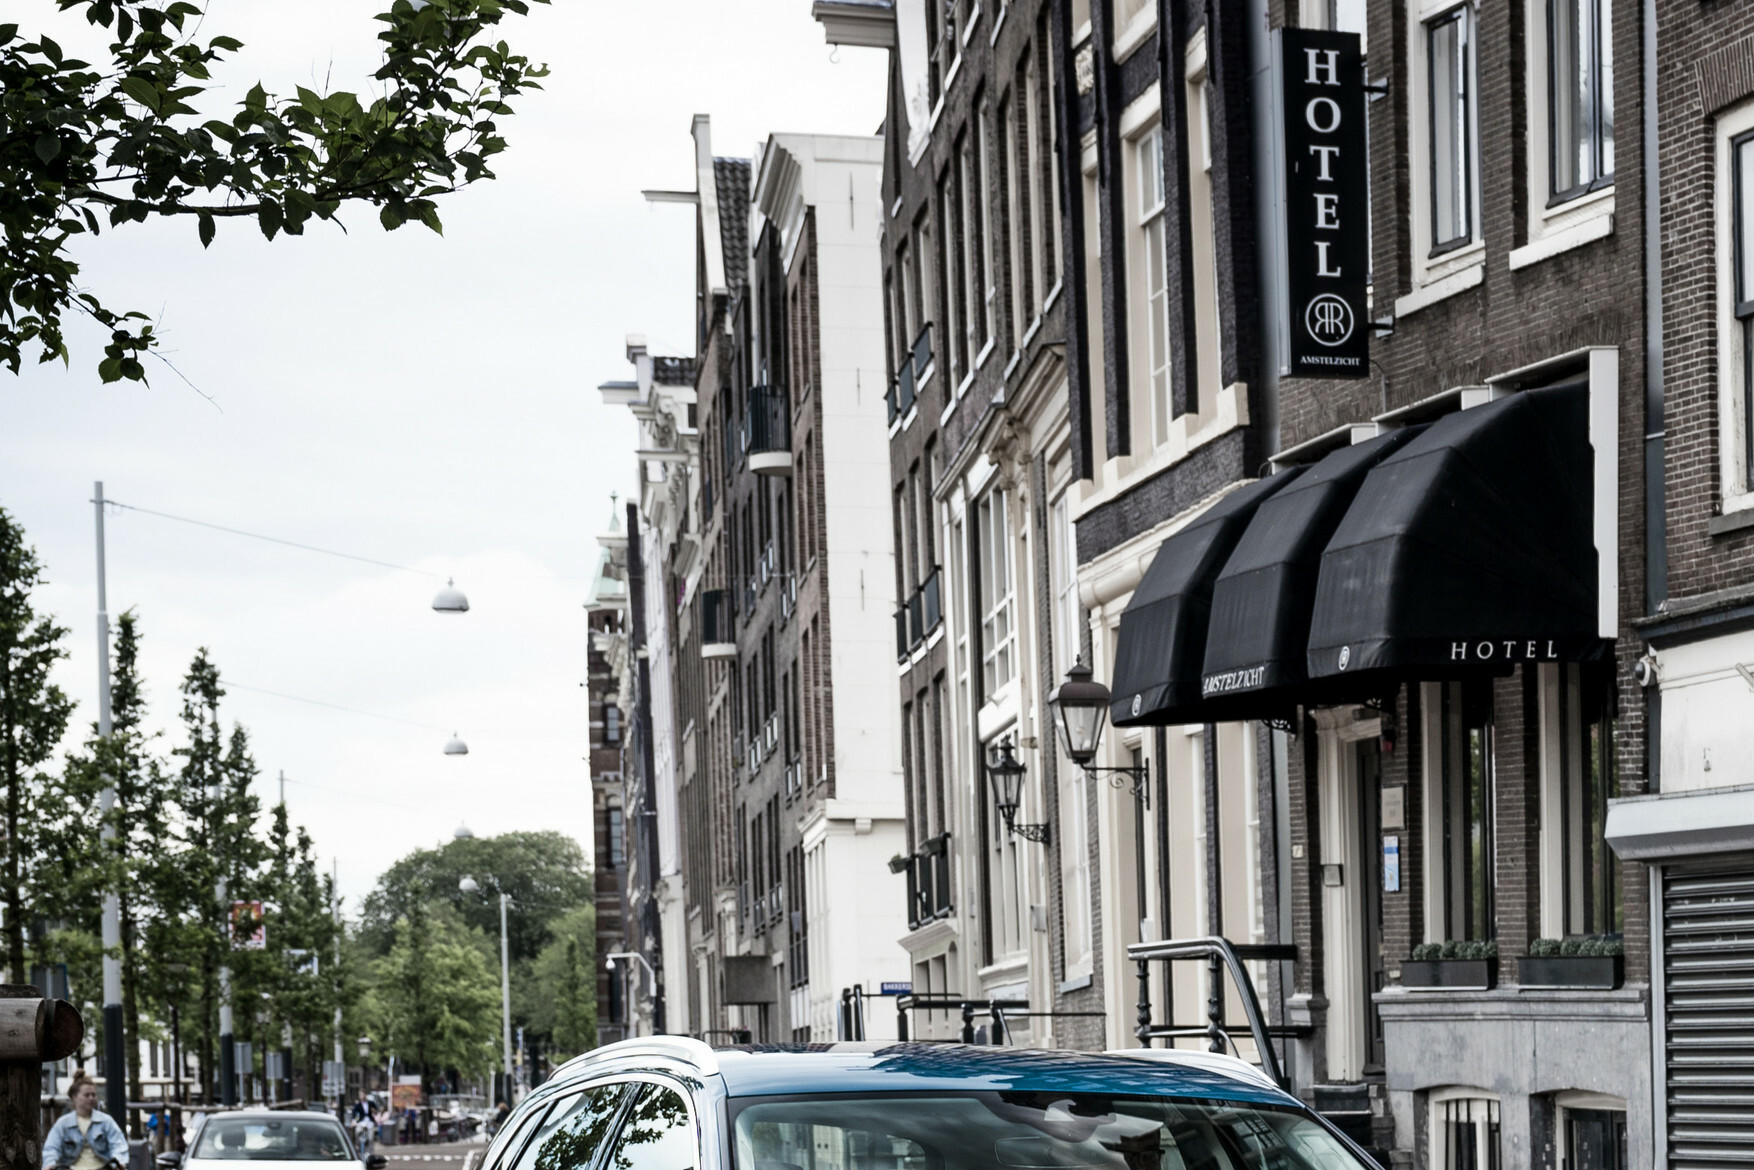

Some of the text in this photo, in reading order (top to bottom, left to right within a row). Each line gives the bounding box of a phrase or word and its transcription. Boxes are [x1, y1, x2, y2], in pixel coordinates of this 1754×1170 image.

[1303, 47, 1342, 278] HOTEL
[1300, 355, 1361, 366] AMSTELZICHT
[1451, 640, 1558, 660] HOTEL
[1203, 666, 1265, 693] AMSTELZICHT
